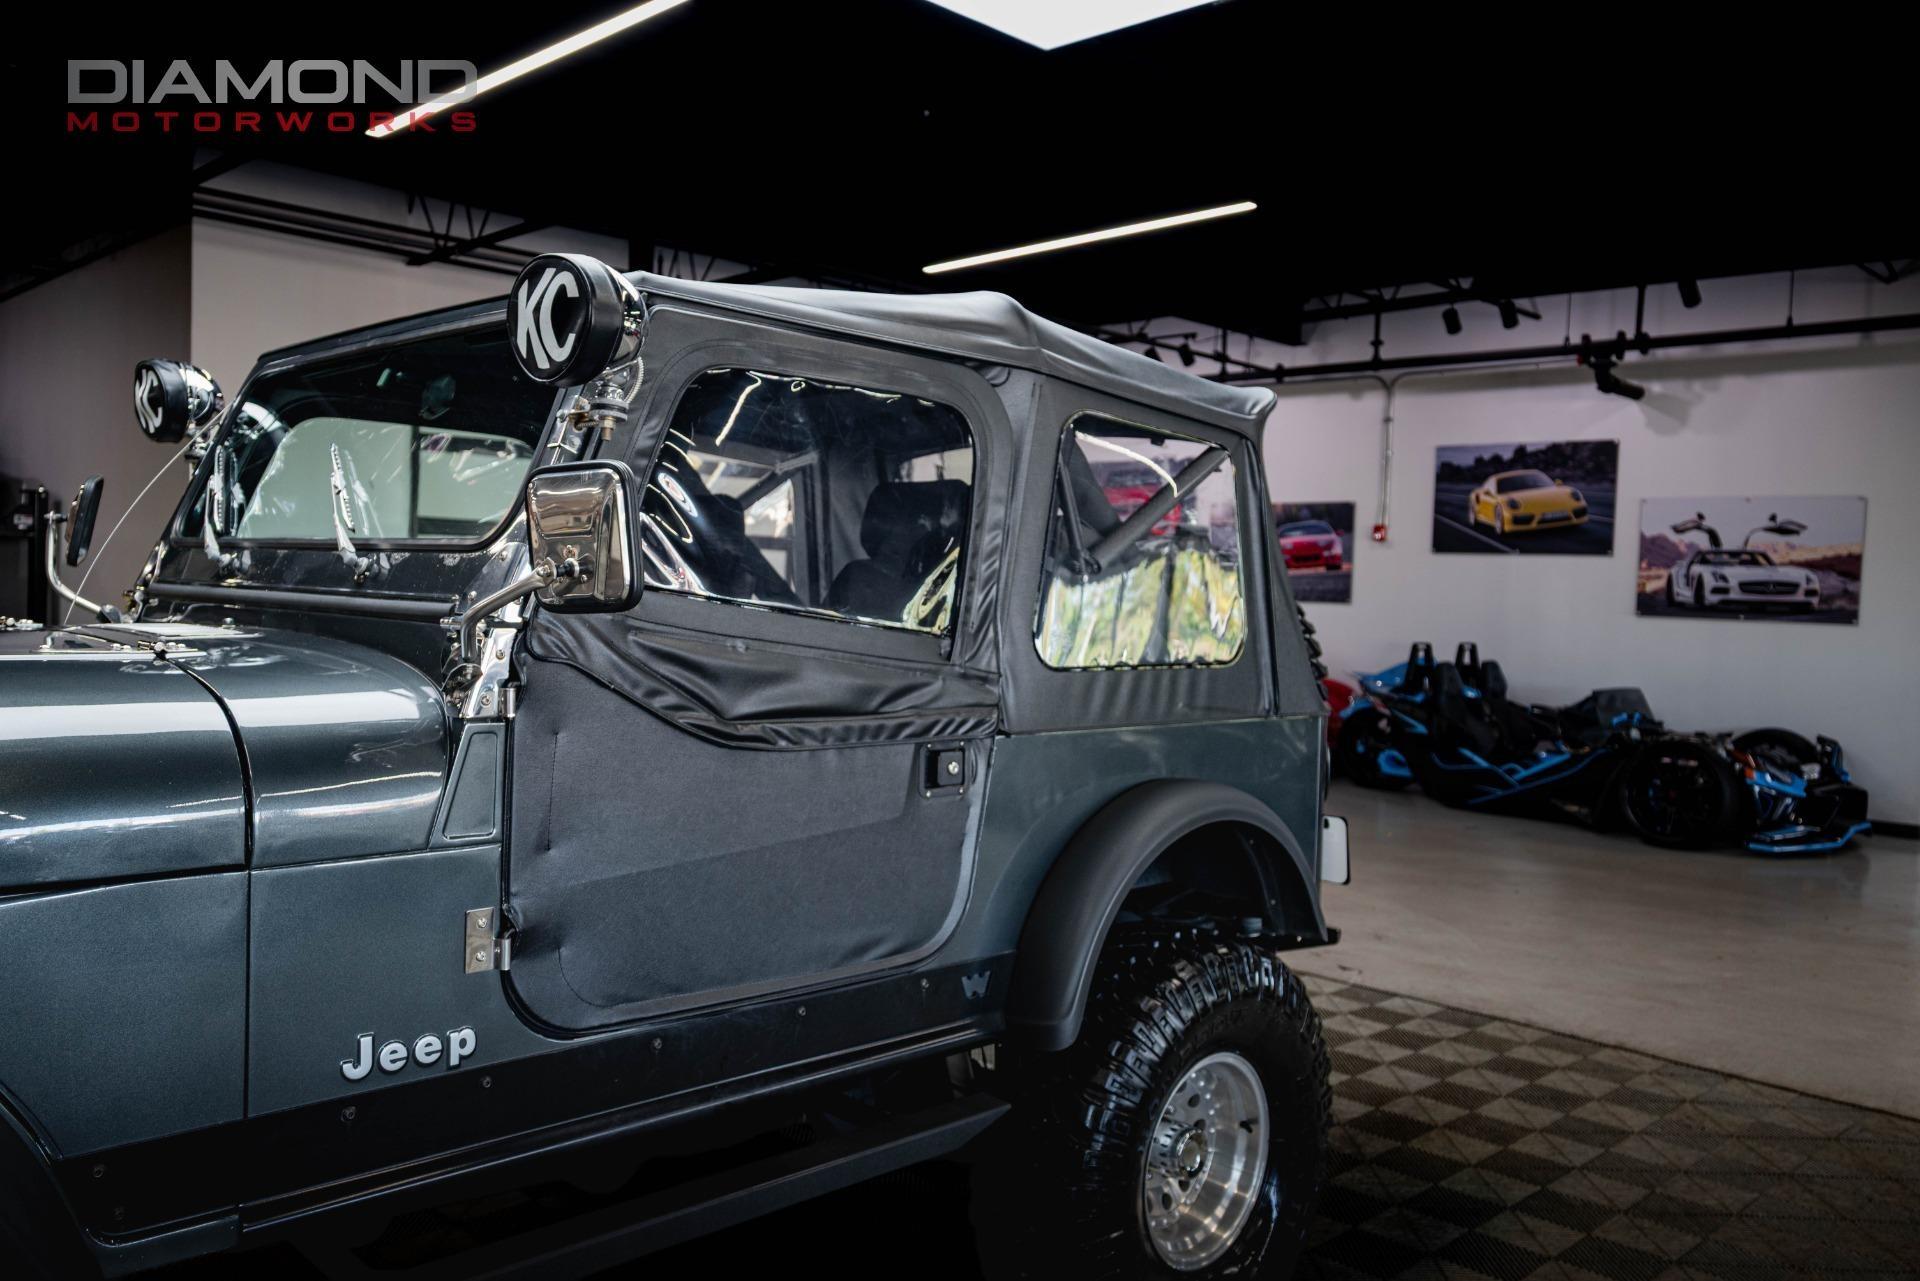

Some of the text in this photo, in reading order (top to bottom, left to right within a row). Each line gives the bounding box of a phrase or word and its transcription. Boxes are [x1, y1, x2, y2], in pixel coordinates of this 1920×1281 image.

[516, 267, 580, 370] KC
[135, 368, 163, 434] KC
[340, 1025, 477, 1081] Jeep
